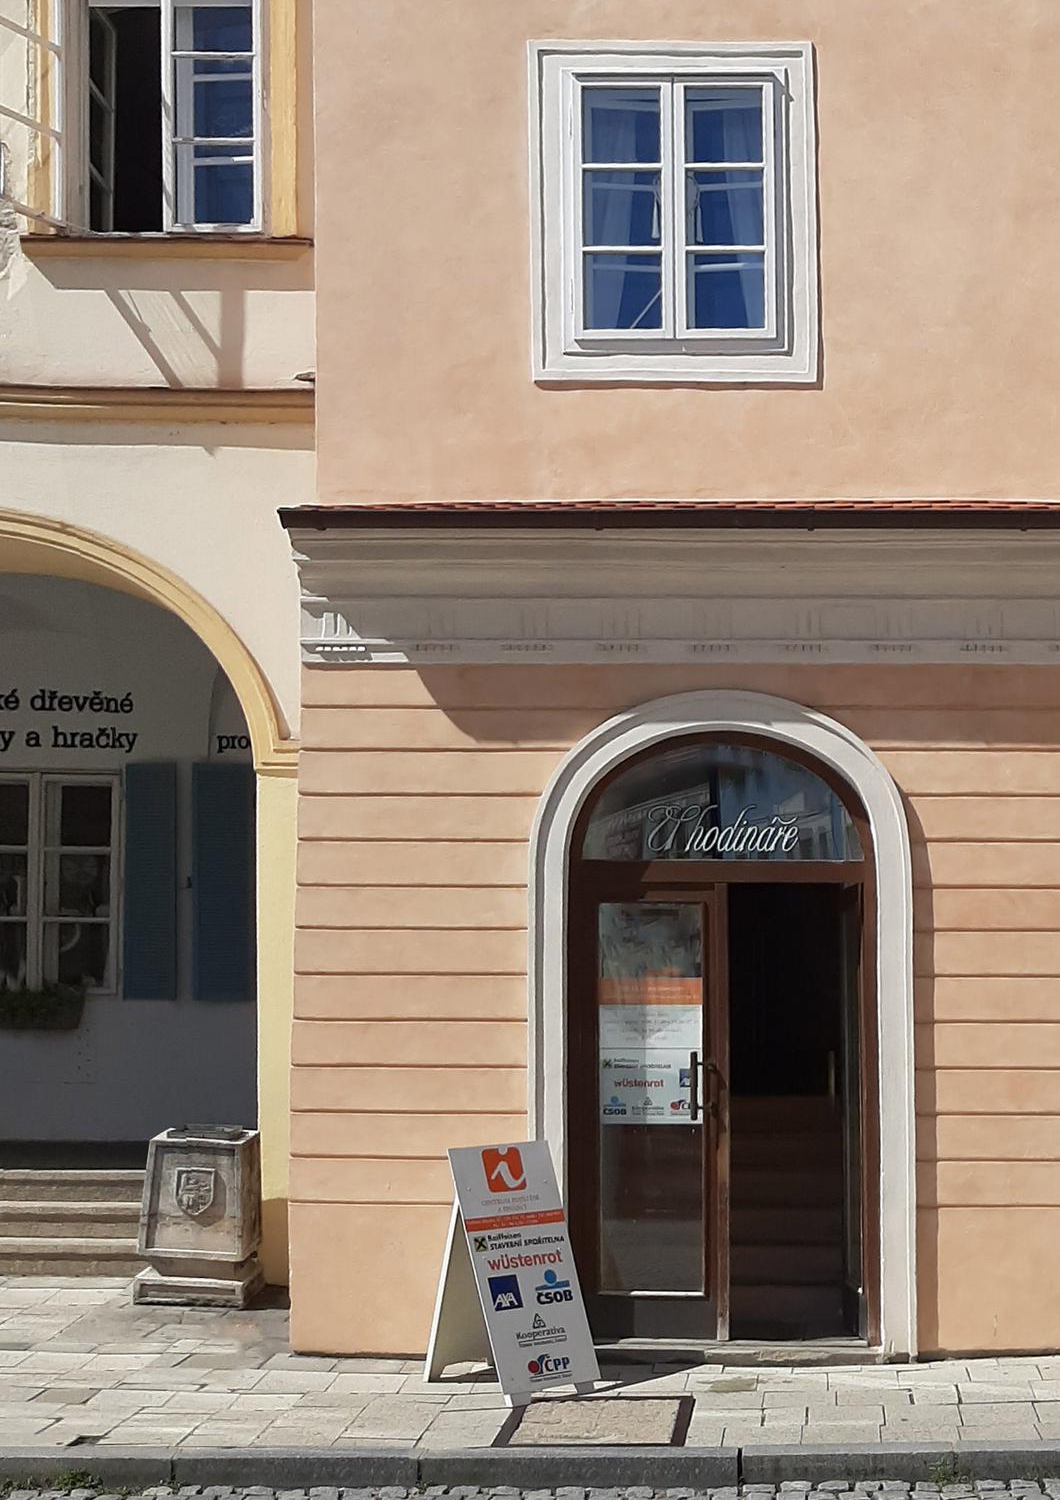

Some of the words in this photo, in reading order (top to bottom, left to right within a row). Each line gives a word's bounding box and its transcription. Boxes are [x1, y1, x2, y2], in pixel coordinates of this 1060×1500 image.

[30, 688, 134, 714] dřevěné
[25, 731, 42, 747] a
[51, 725, 138, 753] hračky
[685, 804, 799, 852] hodináře
[488, 1250, 563, 1271] wüstenrot
[494, 1293, 517, 1309] AXA
[536, 1288, 573, 1305] ČSOB
[516, 1326, 566, 1342] Kooperativa
[544, 1355, 570, 1372] ČPP
